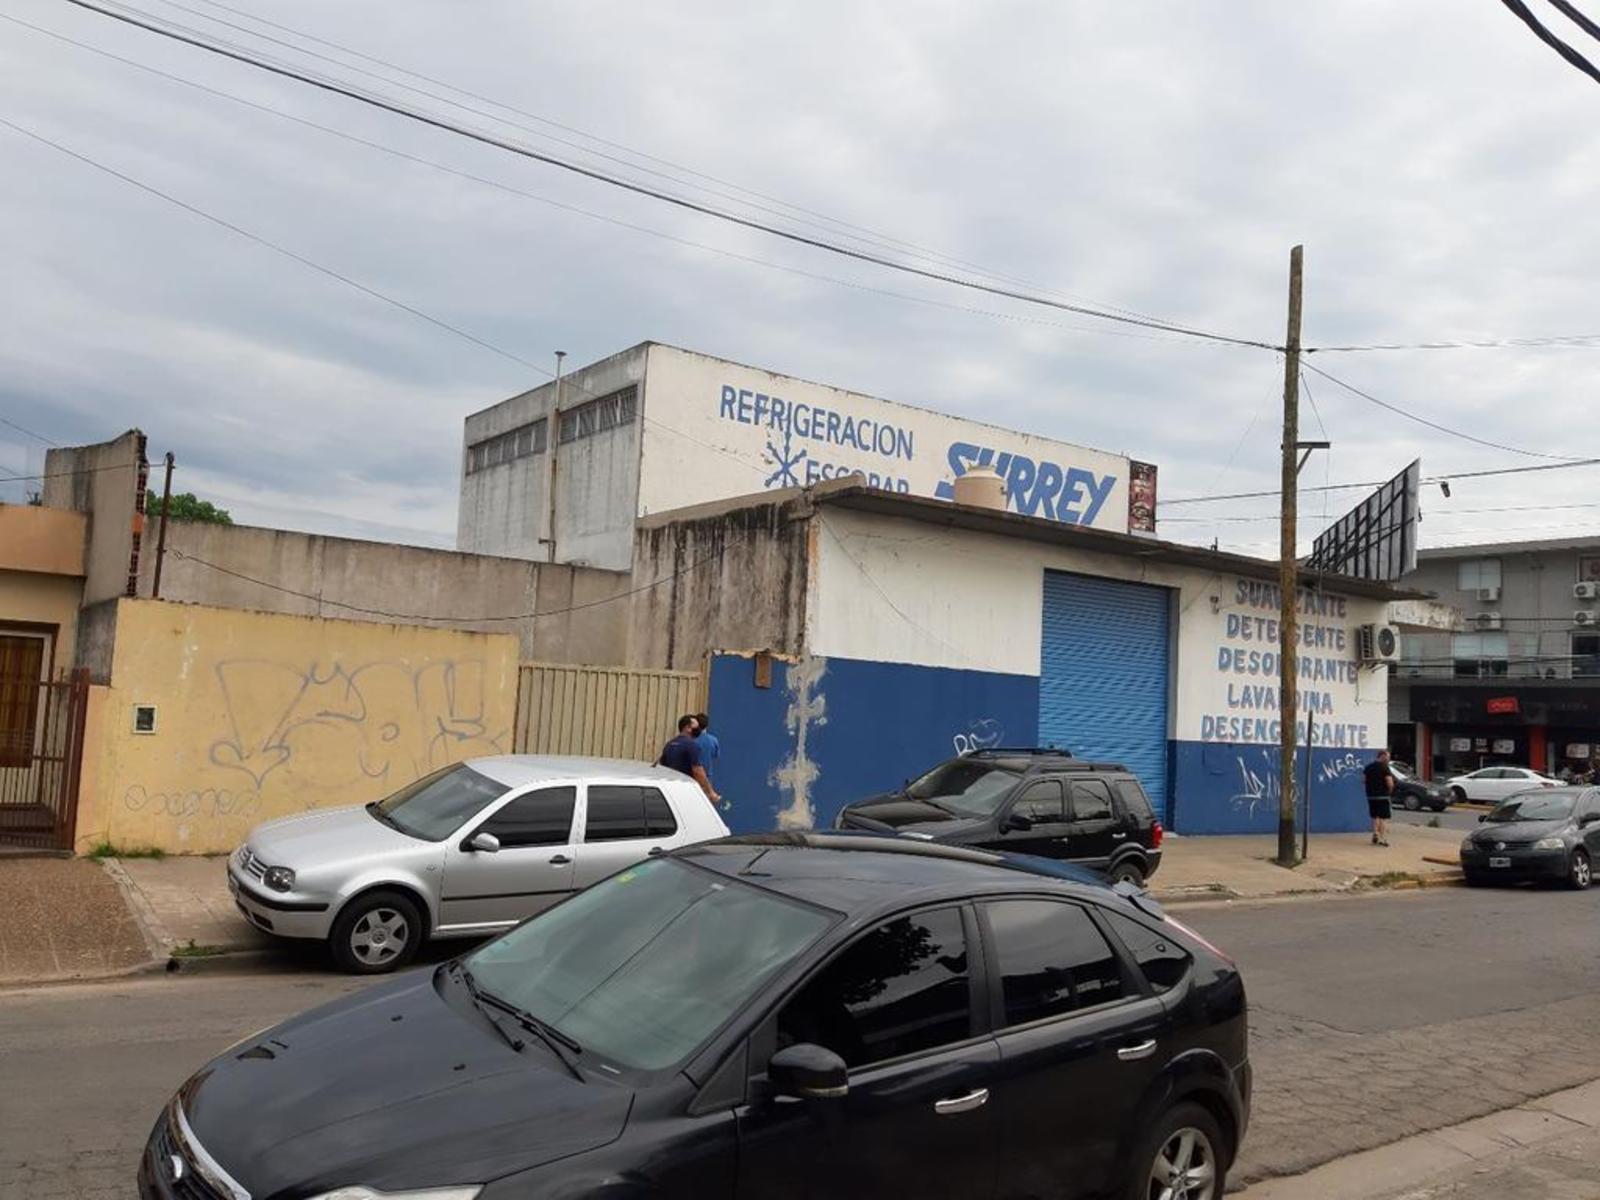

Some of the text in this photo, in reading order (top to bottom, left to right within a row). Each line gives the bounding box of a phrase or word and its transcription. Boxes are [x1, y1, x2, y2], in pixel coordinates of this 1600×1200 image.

[720, 384, 914, 461] REFRIGERACION
[806, 459, 910, 495] ESBAR
[1235, 579, 1346, 619] SUAVANTE
[1226, 613, 1346, 652] DETEENTE
[1218, 647, 1358, 684] DESORANTE
[1227, 683, 1334, 714] LAVAINA
[1201, 715, 1368, 747] DESENGASANTE
